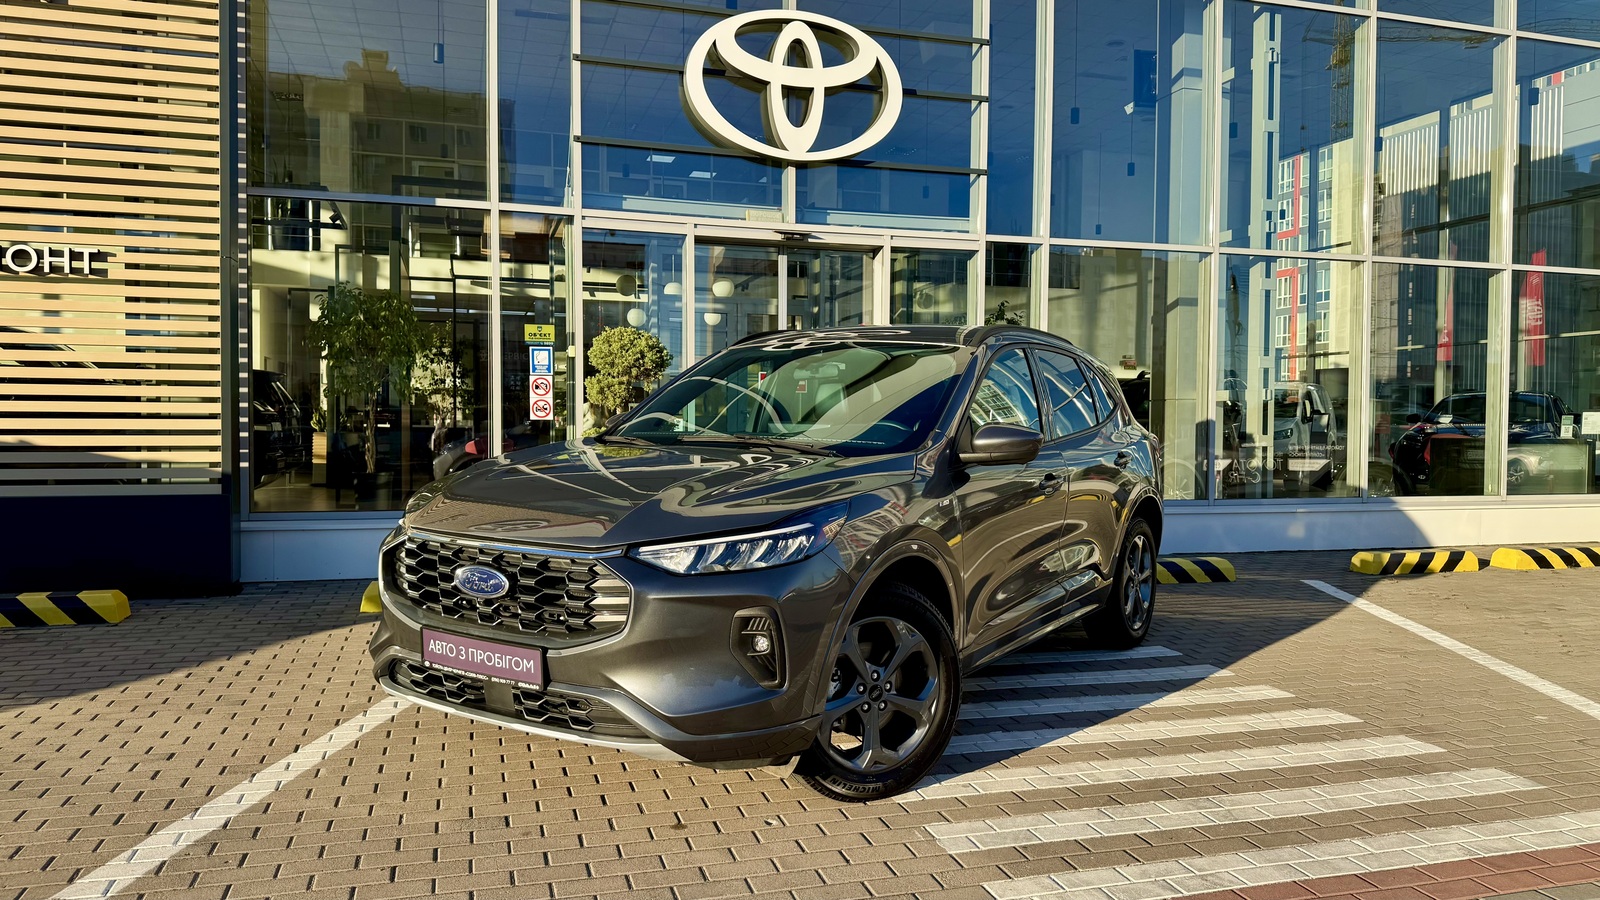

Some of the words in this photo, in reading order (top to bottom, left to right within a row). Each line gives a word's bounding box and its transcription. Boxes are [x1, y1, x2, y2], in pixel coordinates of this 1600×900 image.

[0, 244, 99, 274] ОНТ
[428, 639, 456, 657] АВТО
[468, 648, 535, 674] ПРОБІГОМ
[829, 778, 881, 794] MICHELIN
